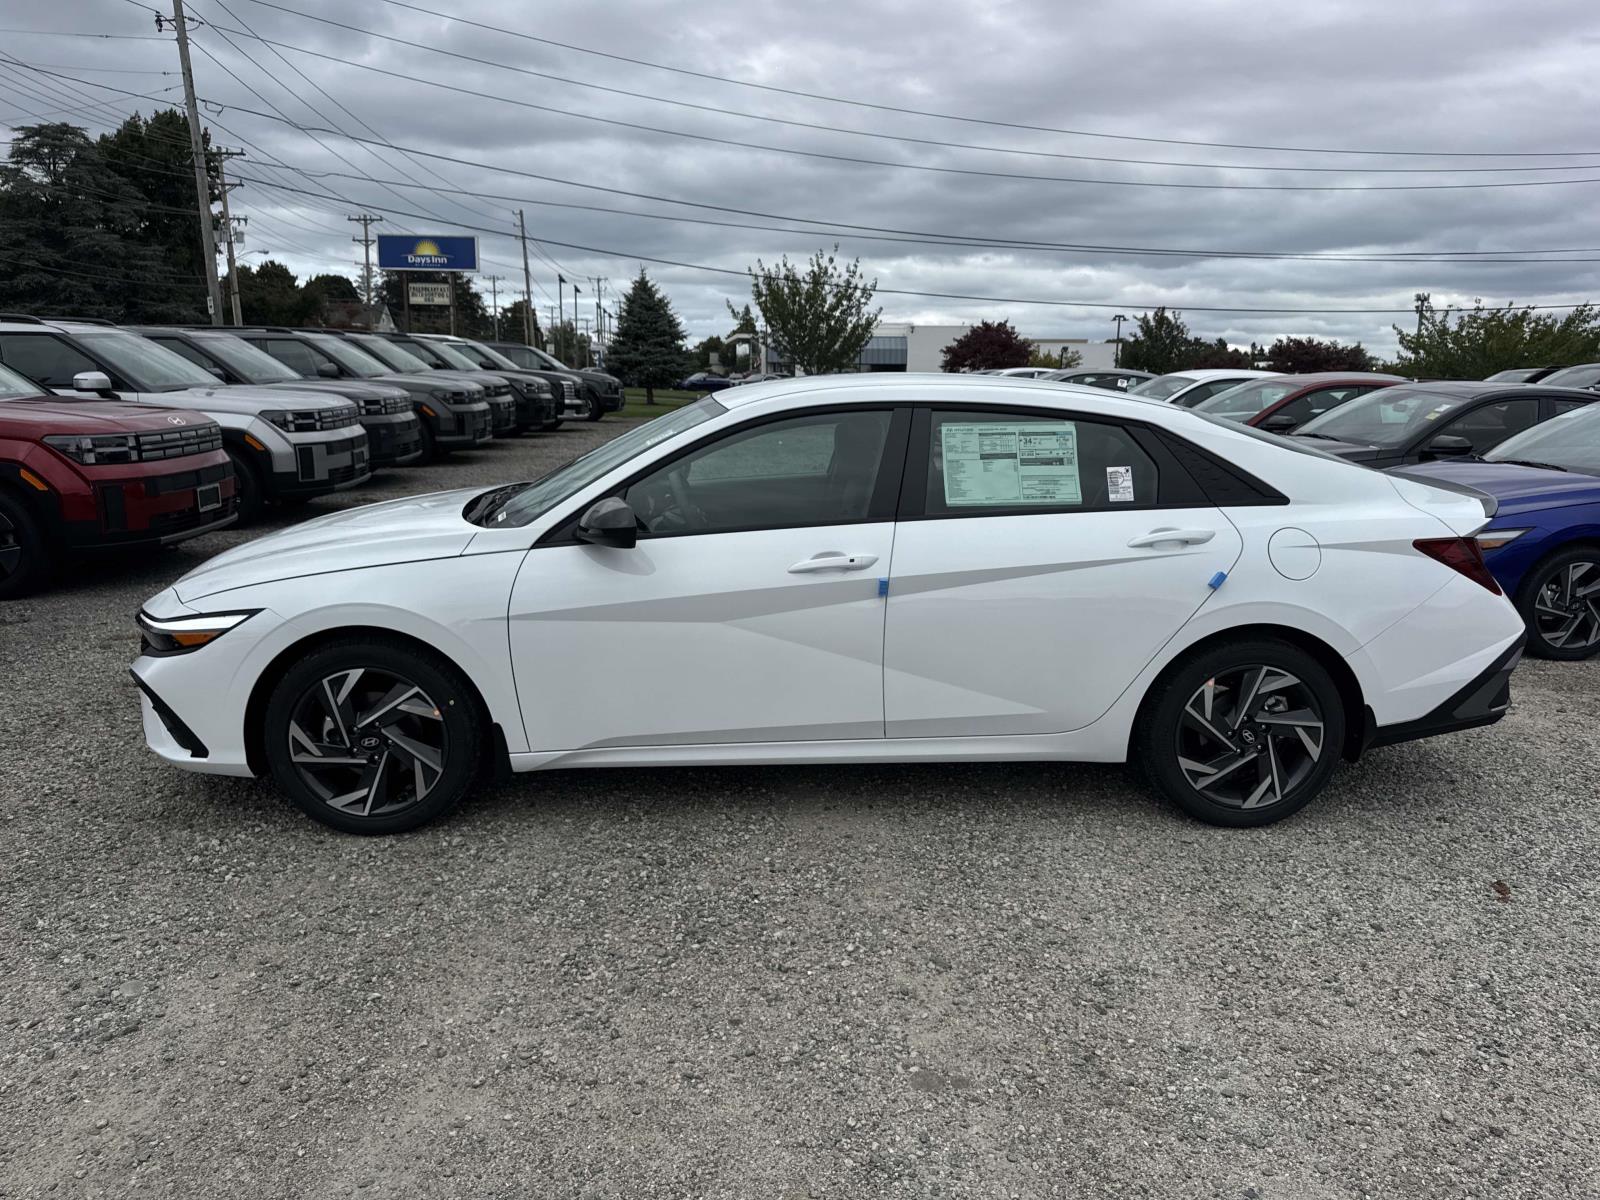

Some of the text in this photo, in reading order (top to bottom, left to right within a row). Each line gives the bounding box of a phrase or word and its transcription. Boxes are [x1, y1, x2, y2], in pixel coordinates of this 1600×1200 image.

[408, 255, 447, 264] Days Inn
[1023, 437, 1032, 446] 34
